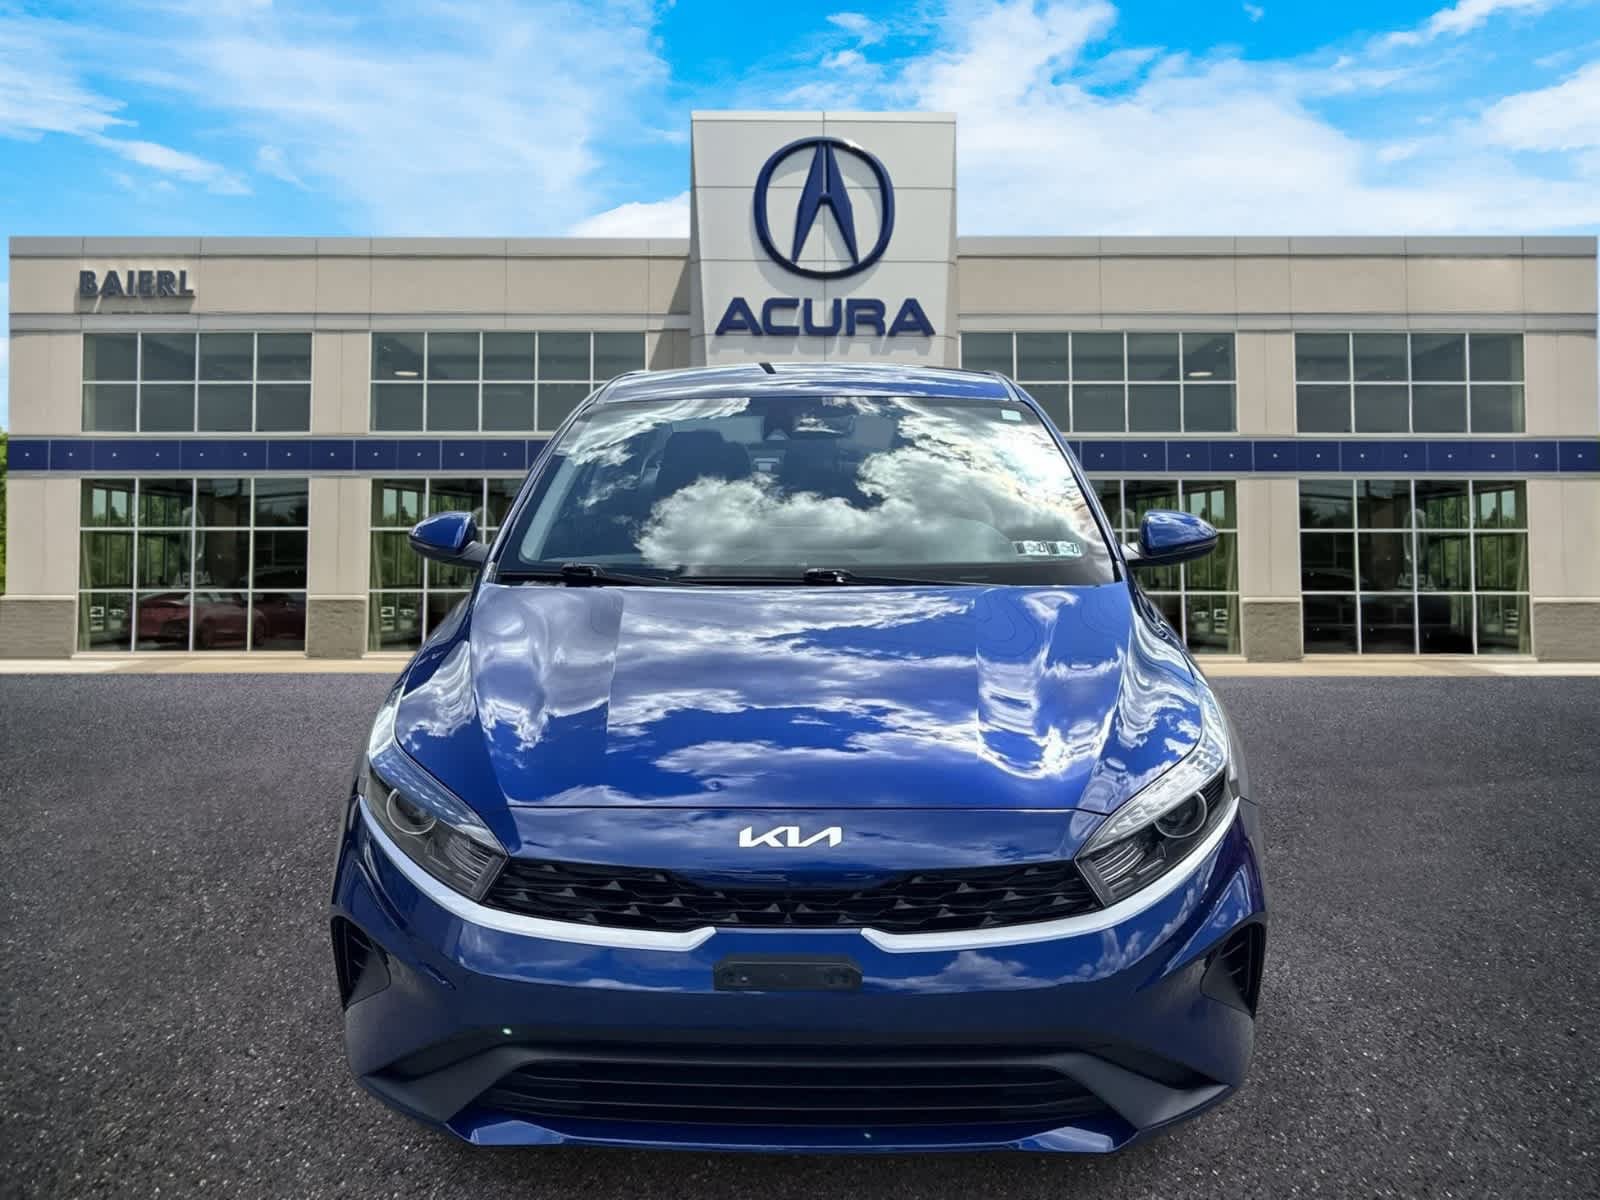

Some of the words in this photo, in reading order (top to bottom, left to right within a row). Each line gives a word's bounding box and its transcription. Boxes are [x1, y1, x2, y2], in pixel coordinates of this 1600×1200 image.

[79, 270, 194, 297] BAIERL
[715, 297, 936, 337] ACURA
[738, 825, 842, 848] KIA
